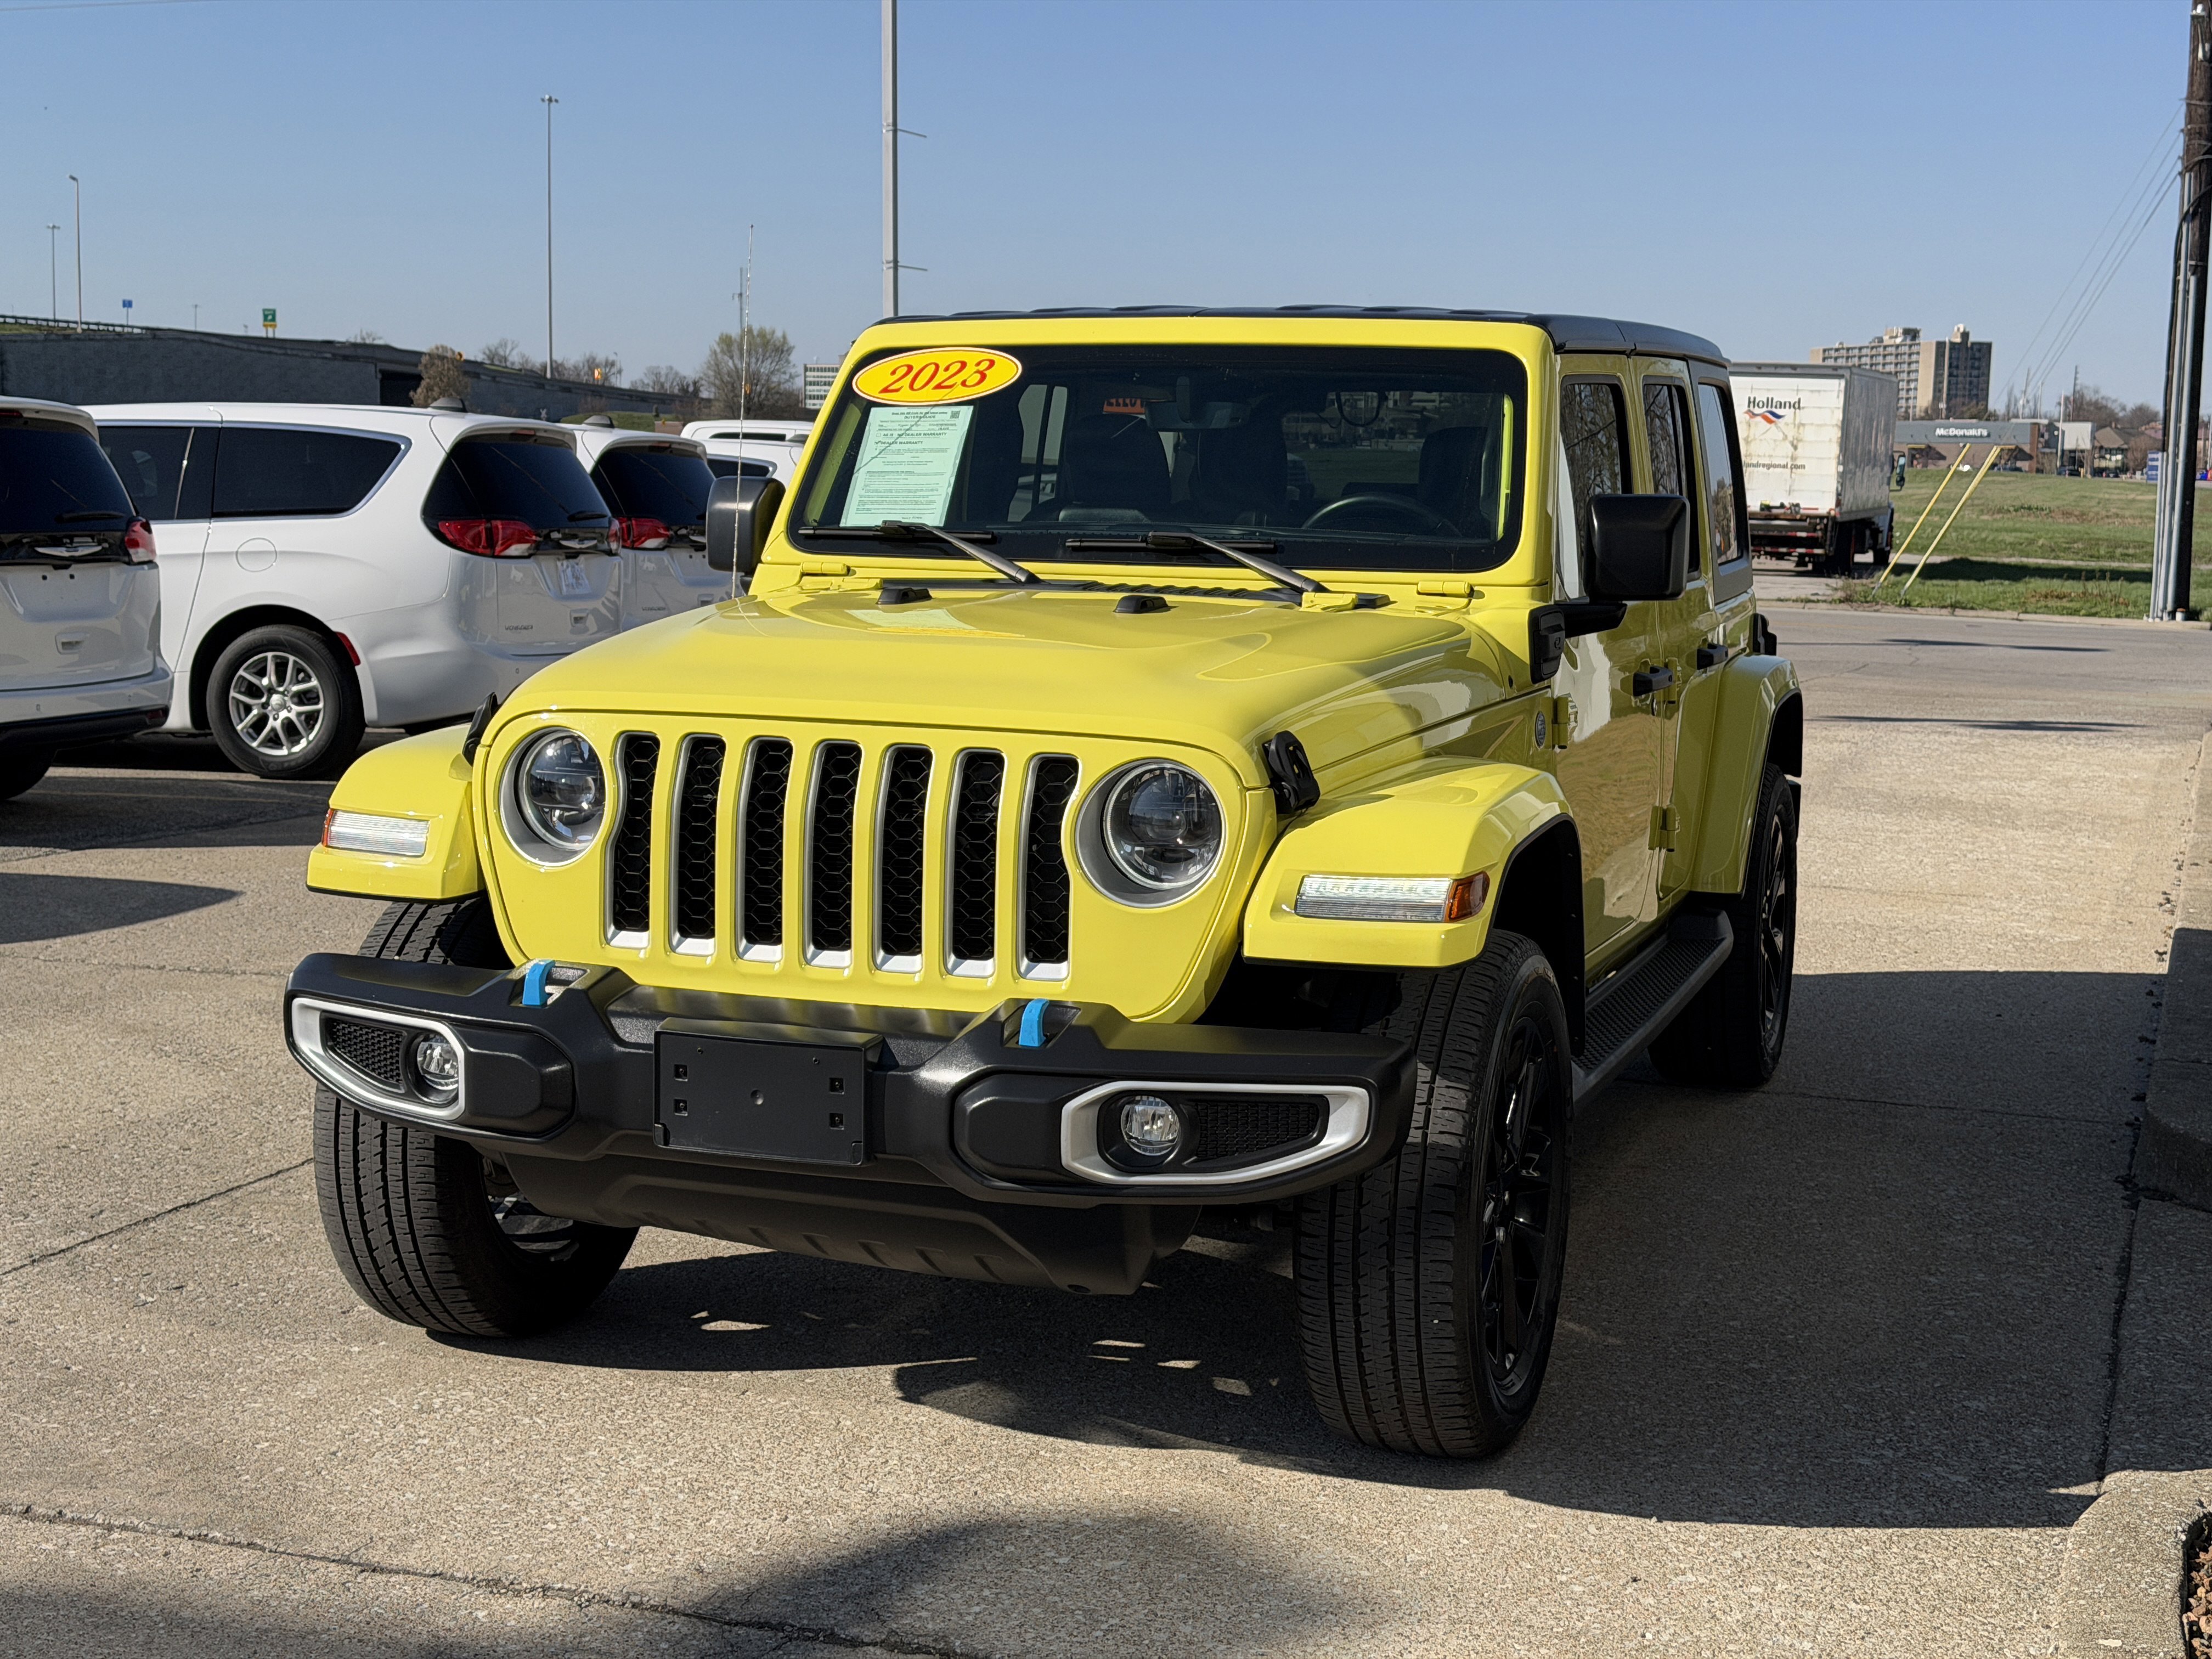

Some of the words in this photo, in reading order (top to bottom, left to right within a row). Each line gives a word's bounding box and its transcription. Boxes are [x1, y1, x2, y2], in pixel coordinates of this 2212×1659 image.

[878, 358, 996, 394] 2023
[1747, 396, 1801, 410] Holland
[1935, 427, 1988, 437] McDonald's
